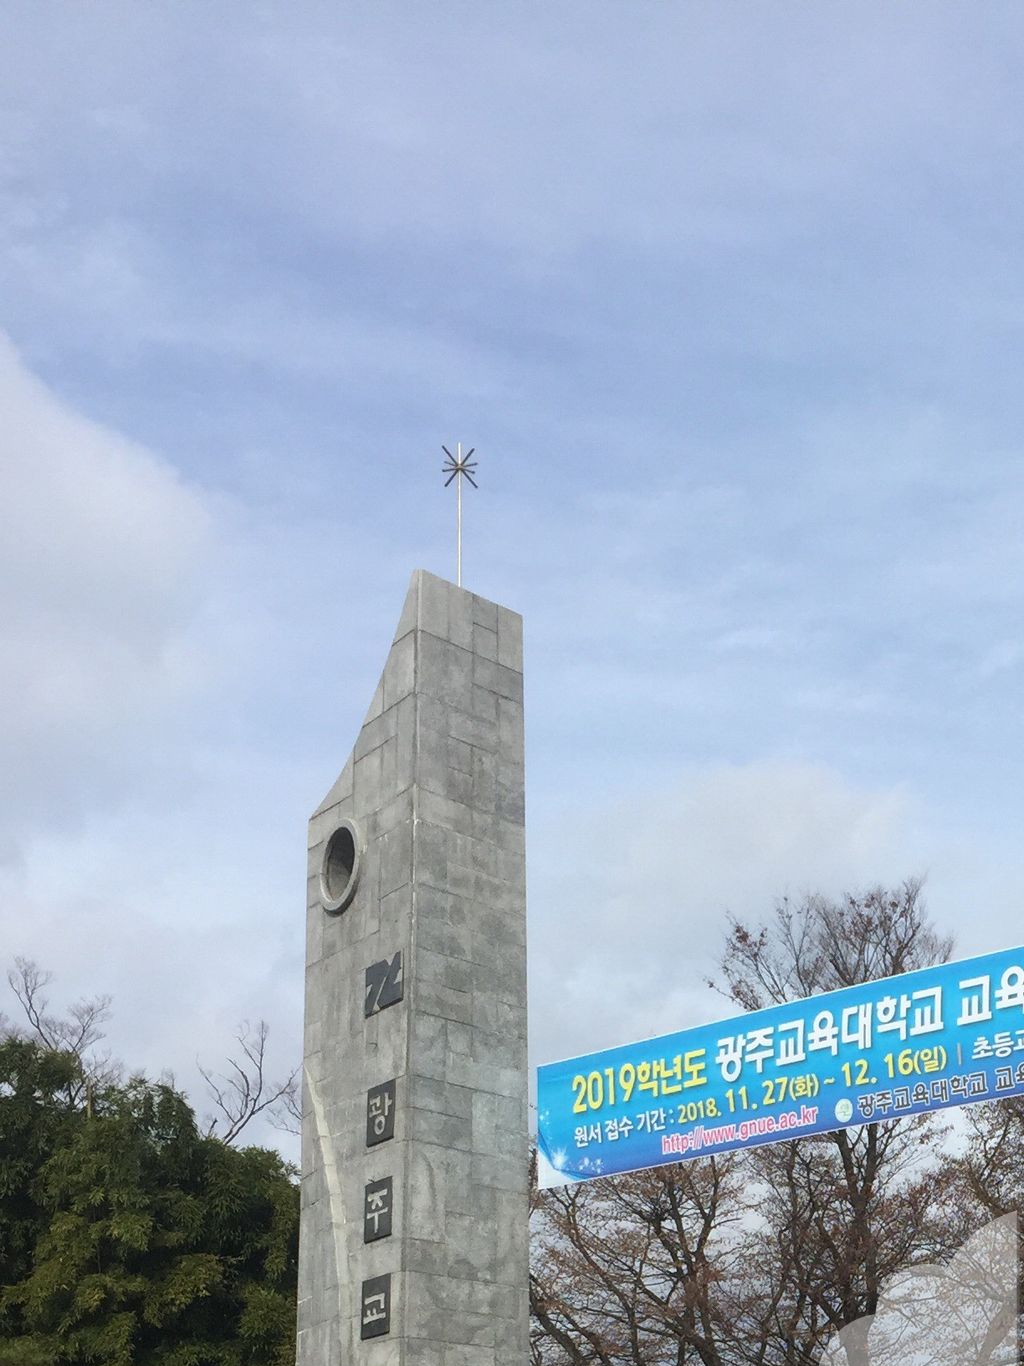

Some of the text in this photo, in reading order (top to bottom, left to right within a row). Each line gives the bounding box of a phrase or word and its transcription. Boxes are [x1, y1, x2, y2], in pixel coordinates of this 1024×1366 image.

[572, 1049, 707, 1114] 2019학년도
[716, 987, 944, 1083] 광주교육대학교
[574, 1123, 603, 1148] 원서
[604, 1116, 633, 1140] 접수
[677, 1098, 721, 1124] 2018.
[725, 1085, 758, 1112] 11.
[761, 1073, 819, 1106] 27(화)
[841, 1058, 878, 1087] 12.
[884, 1046, 947, 1079] 16(일)
[661, 1104, 818, 1155] http://www.gnue.ac.kr
[857, 1071, 988, 1118] 광주교육대학교
